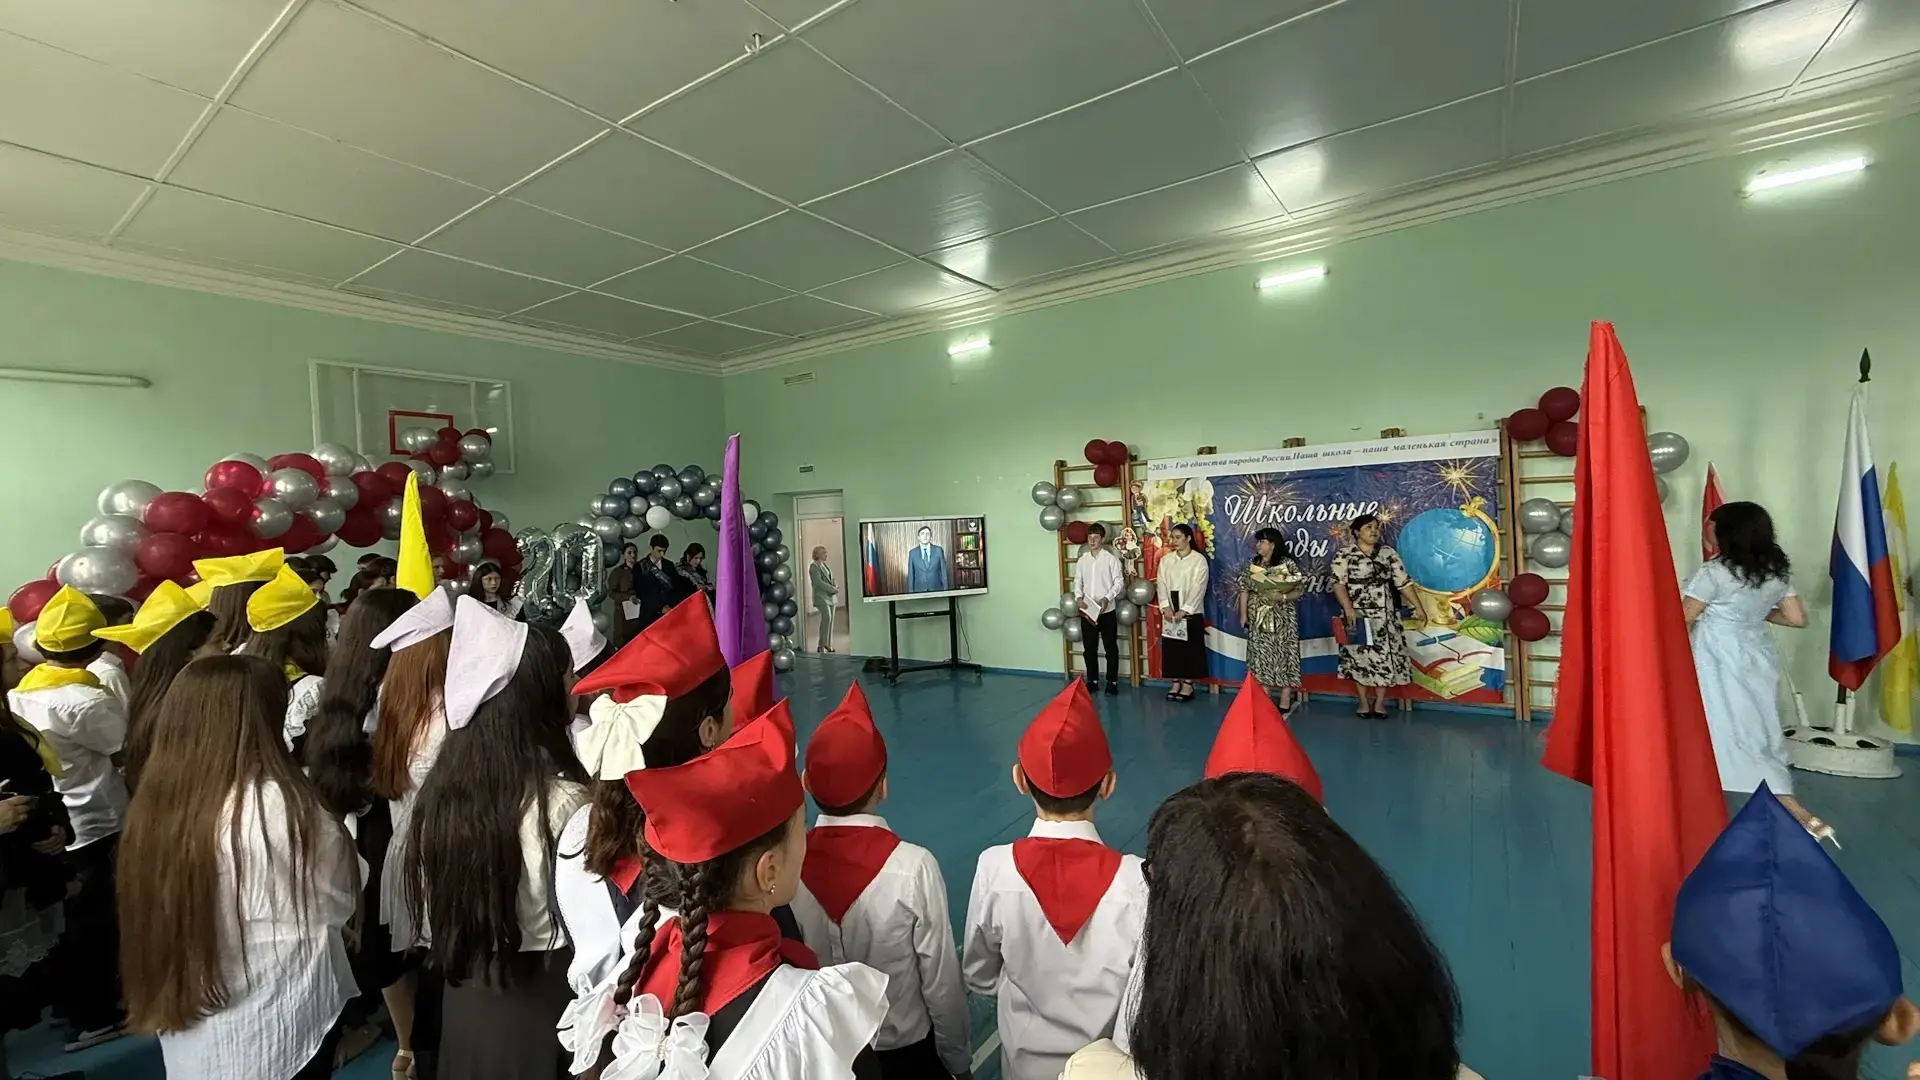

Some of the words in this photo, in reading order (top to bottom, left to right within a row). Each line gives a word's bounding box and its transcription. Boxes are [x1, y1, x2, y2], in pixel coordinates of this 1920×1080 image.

[1175, 461, 1189, 469] Год
[1190, 459, 1227, 468] единства
[1228, 456, 1260, 467] народов
[1322, 448, 1352, 457] школа
[1362, 445, 1388, 454] наша
[1391, 441, 1446, 451] маленькая
[1224, 494, 1379, 525] Школьные
